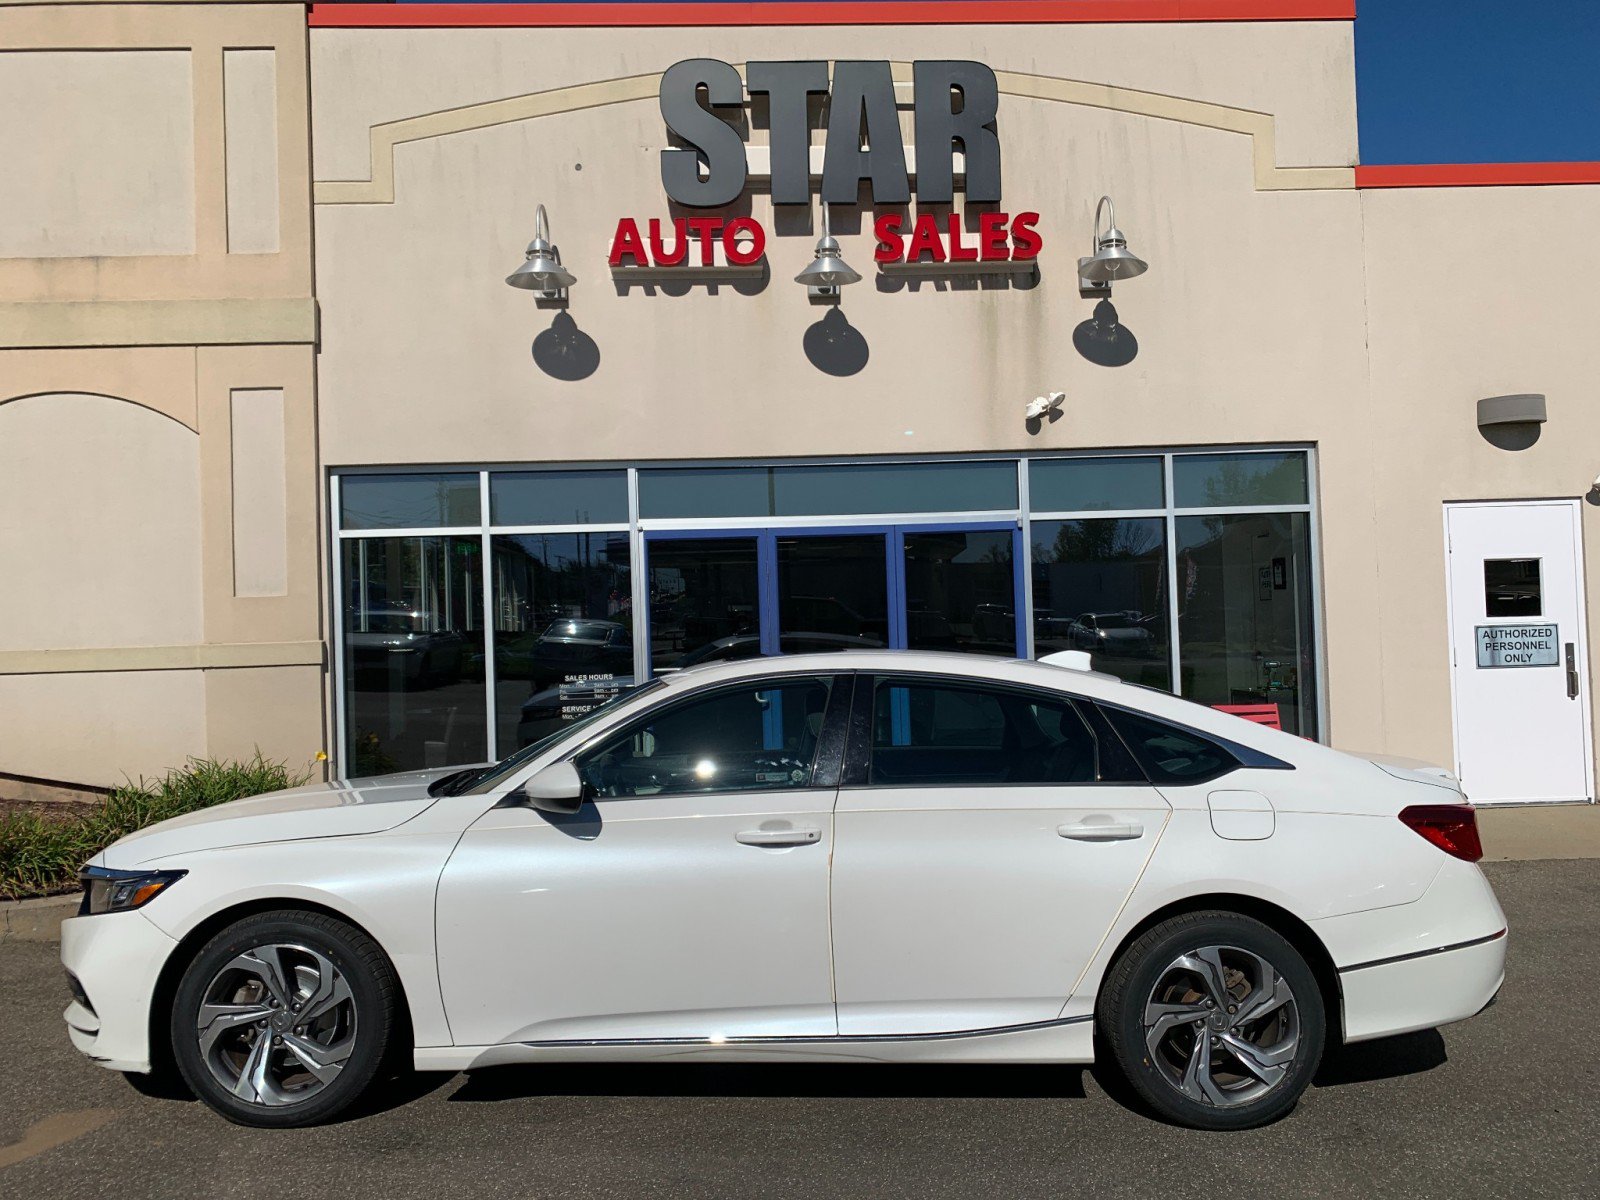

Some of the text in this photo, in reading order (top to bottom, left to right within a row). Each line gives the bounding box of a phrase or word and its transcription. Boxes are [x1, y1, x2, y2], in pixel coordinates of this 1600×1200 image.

[660, 58, 1001, 206] STAR
[608, 212, 1043, 266] AUTO SALES
[1483, 628, 1552, 639] AUTHORIZED
[1485, 641, 1551, 651] PERSONNEL
[1504, 653, 1533, 663] ONLY
